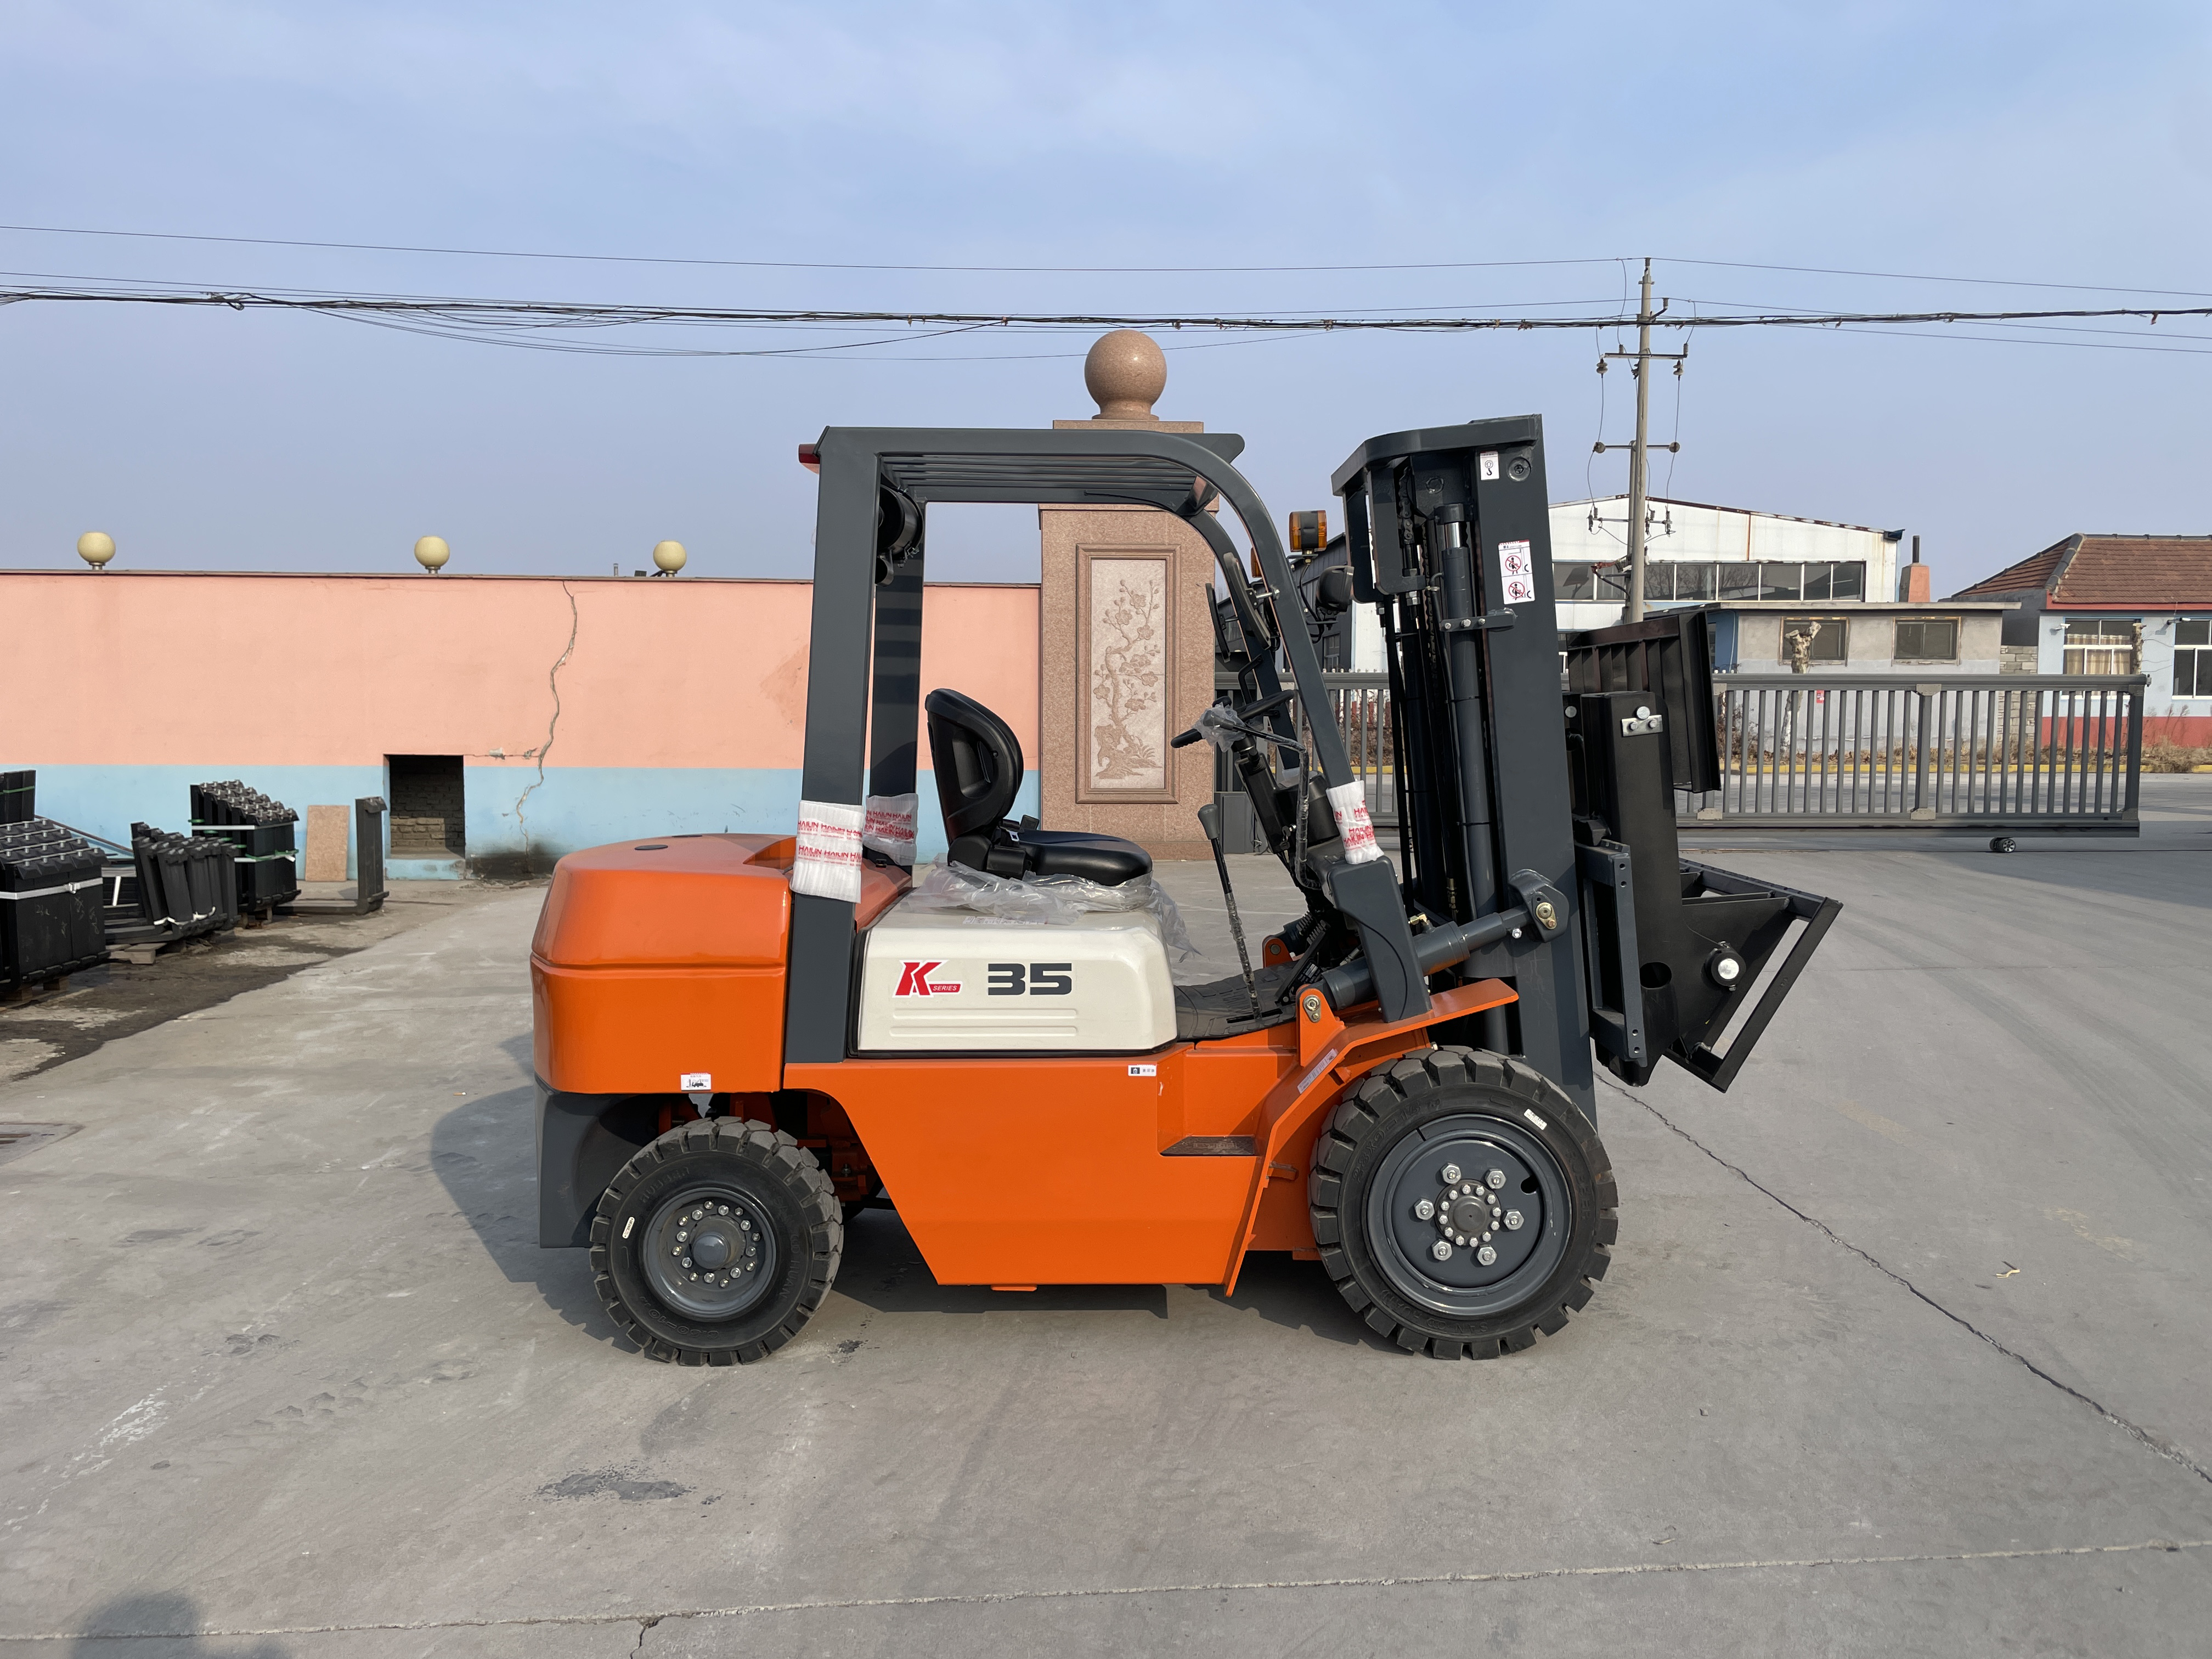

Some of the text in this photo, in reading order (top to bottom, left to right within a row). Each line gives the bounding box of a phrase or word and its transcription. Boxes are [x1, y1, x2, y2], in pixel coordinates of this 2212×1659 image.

[799, 845, 822, 855] HAILIN
[824, 850, 849, 858] HAILIN
[895, 962, 942, 996] K
[988, 963, 1072, 996] 35
[778, 1260, 800, 1299] HUAN
